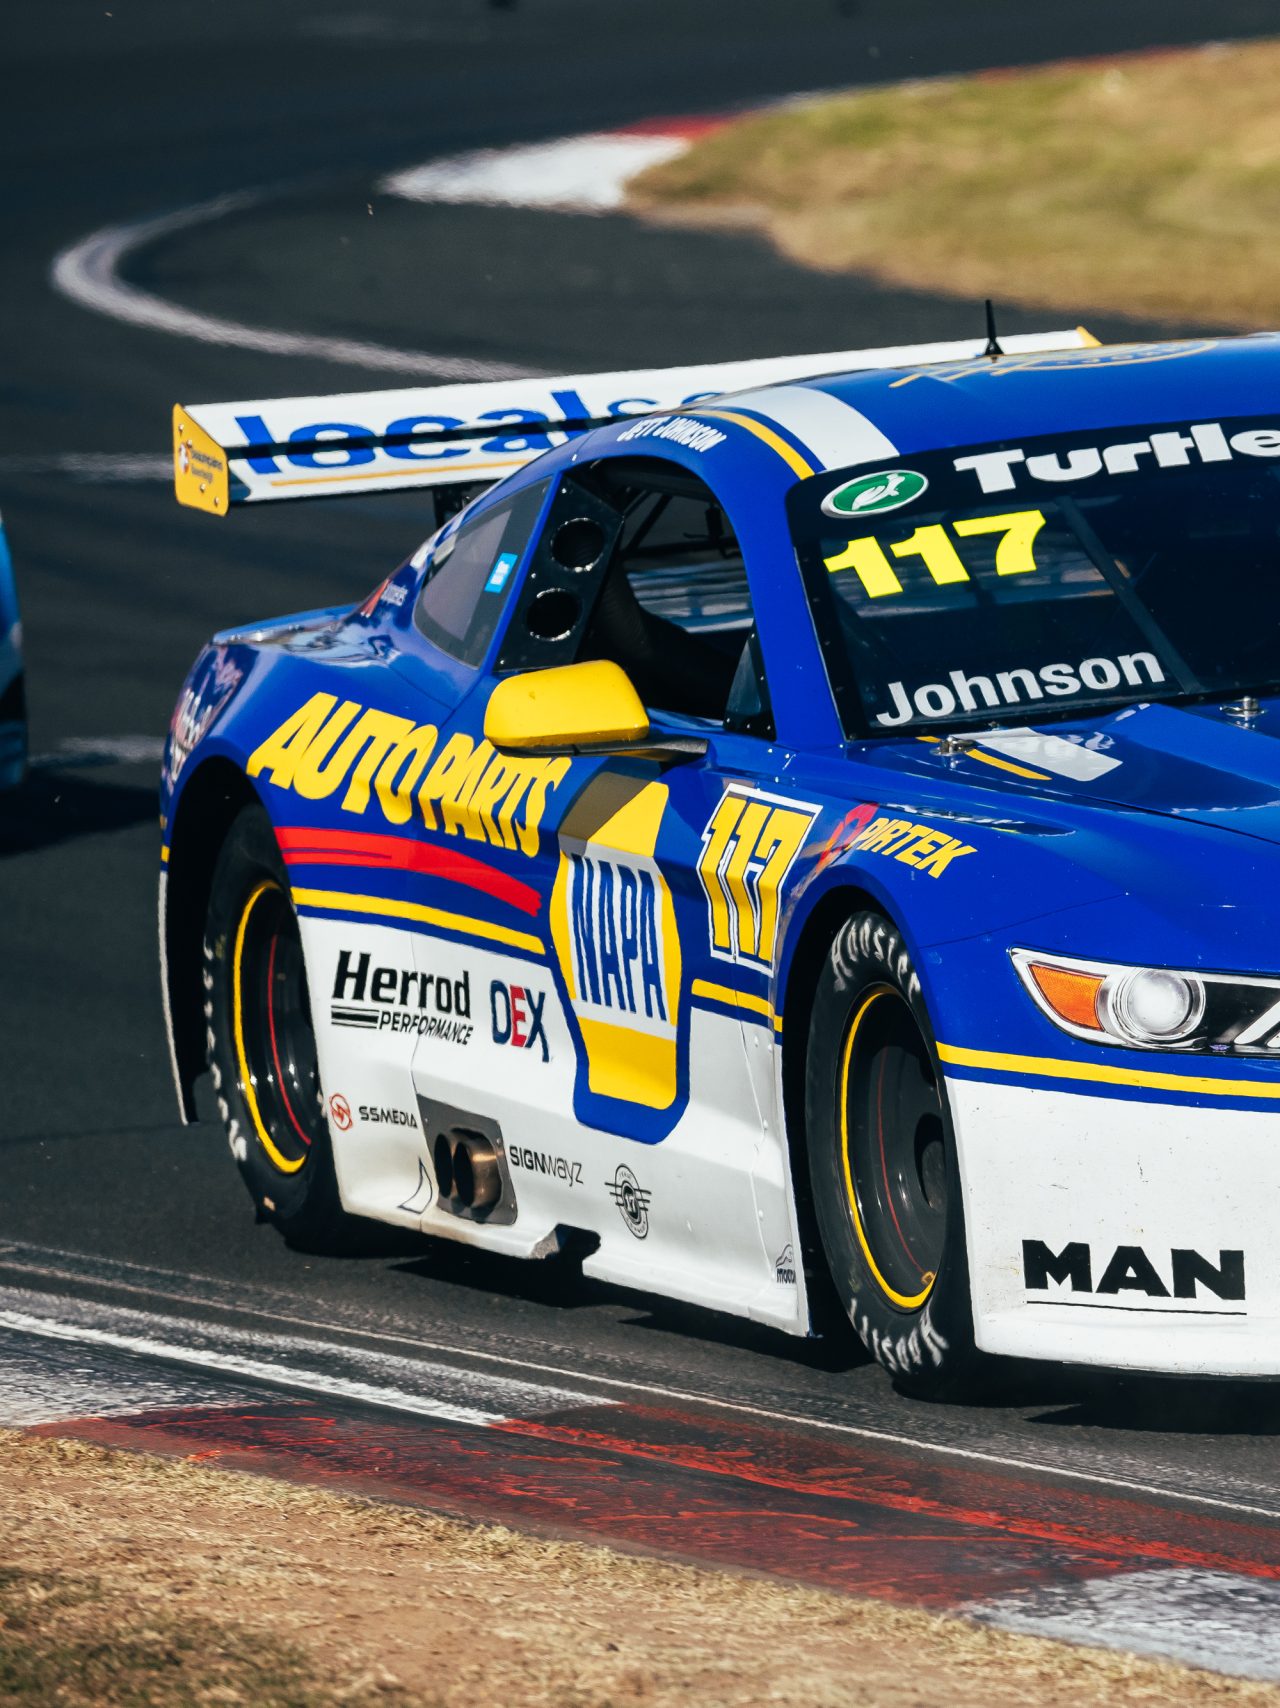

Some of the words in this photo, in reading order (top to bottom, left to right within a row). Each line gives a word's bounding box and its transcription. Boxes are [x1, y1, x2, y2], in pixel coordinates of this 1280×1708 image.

[823, 509, 1046, 598] 117
[875, 651, 1166, 727] Johnson
[246, 692, 438, 825] AUTO
[418, 732, 572, 857] PARTS
[701, 793, 813, 965] 117
[845, 817, 979, 879] PIRTEK
[571, 853, 667, 1021] NAPA
[332, 949, 471, 1018] Herrod
[490, 980, 549, 1063] DEX
[378, 1007, 474, 1046] PERFORMANCE
[1022, 1239, 1246, 1300] MAN
